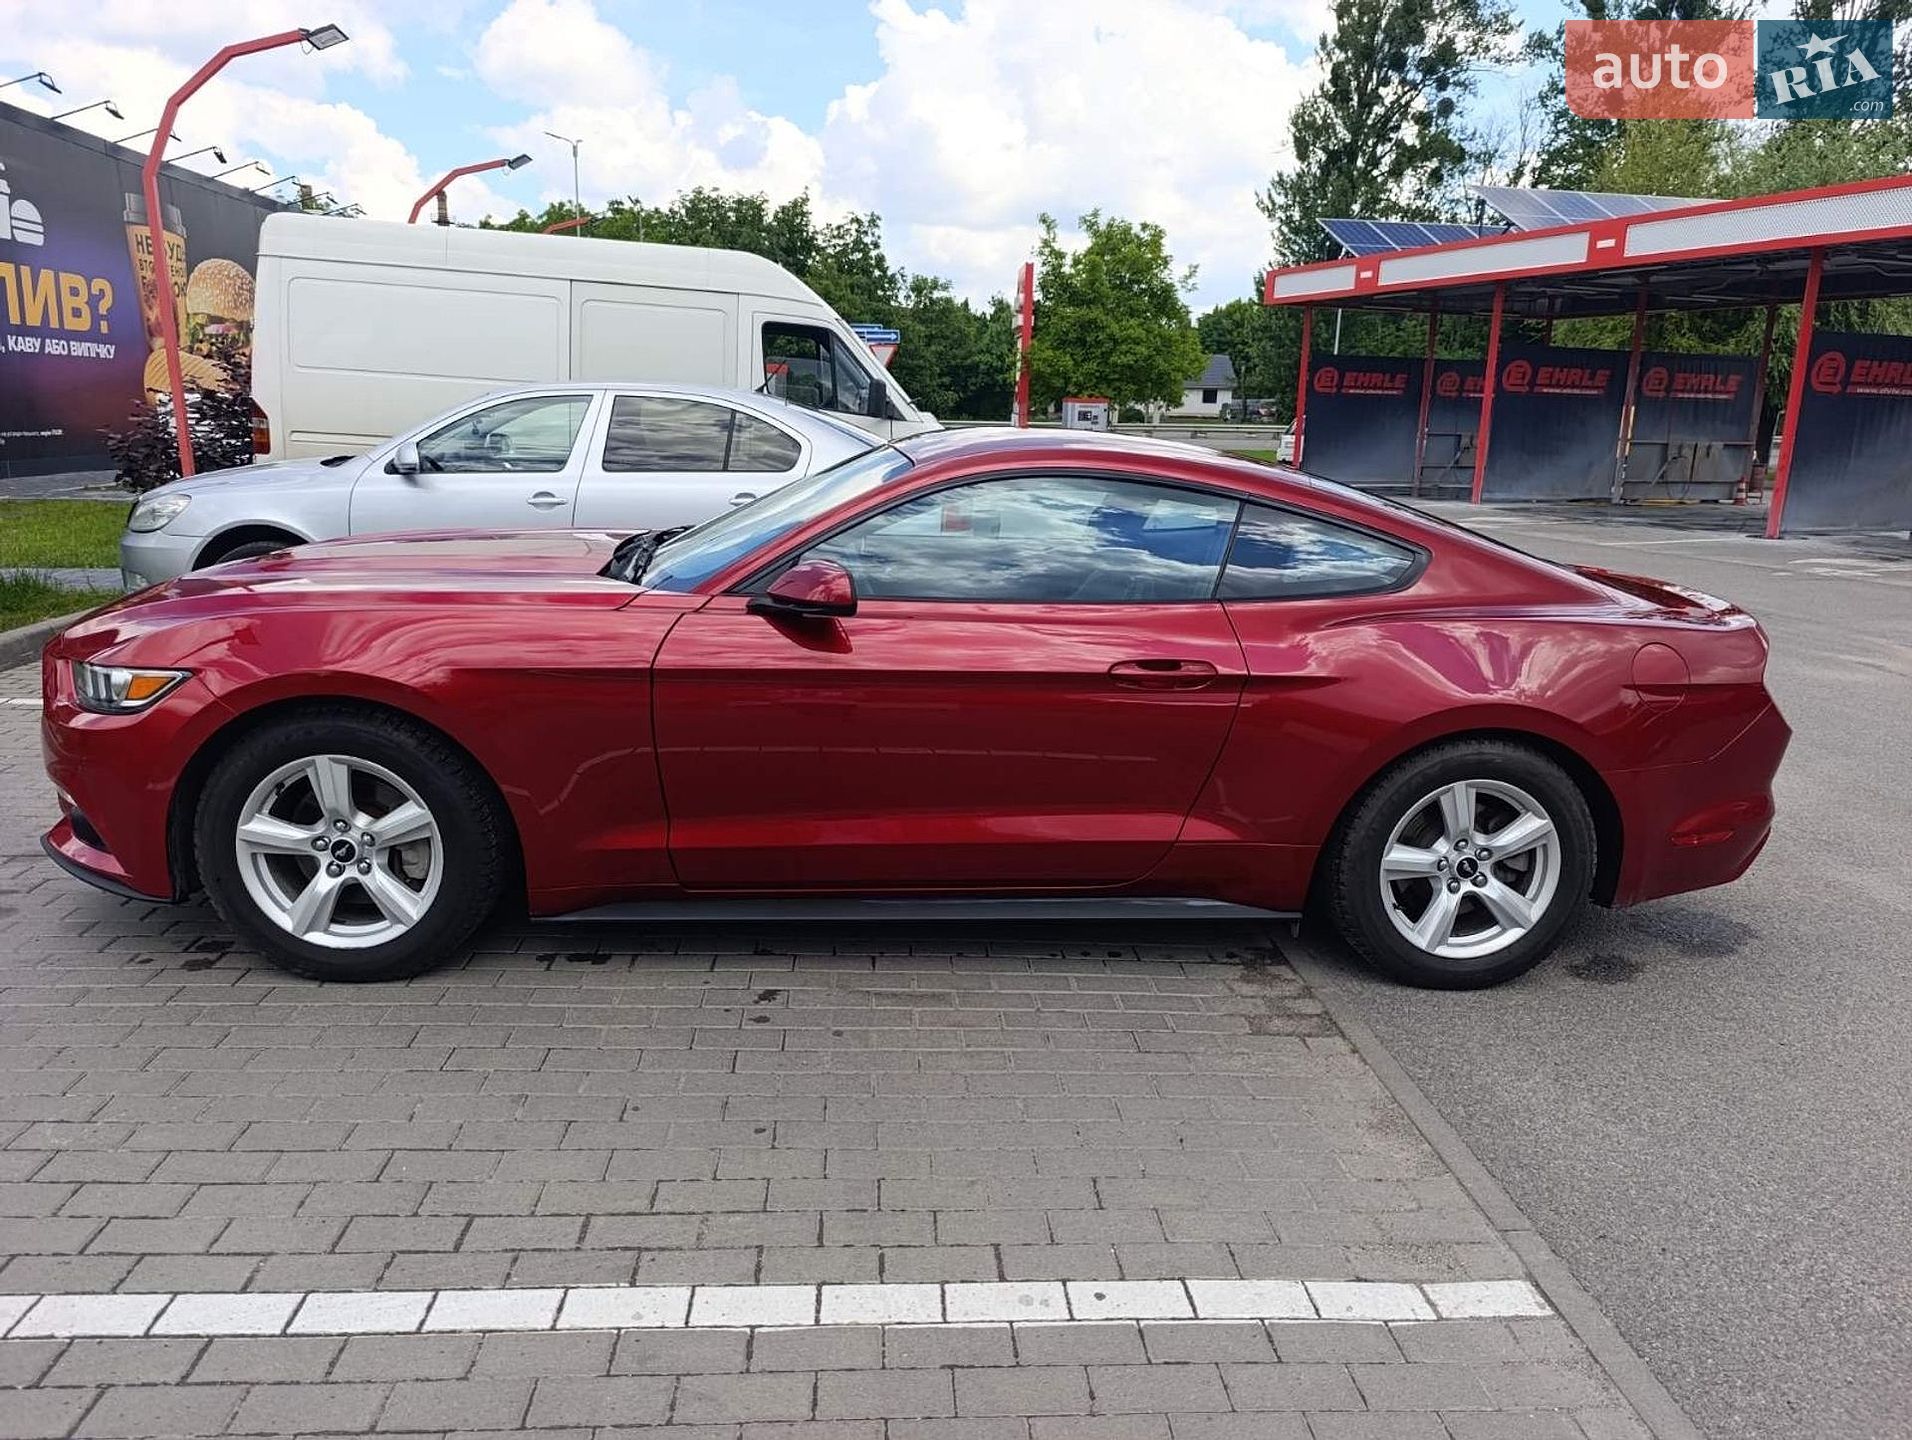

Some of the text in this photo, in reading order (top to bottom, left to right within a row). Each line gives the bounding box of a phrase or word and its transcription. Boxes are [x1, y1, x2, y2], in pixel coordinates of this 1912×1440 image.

[7, 334, 41, 353] КАВУ
[44, 338, 68, 355] АБО
[1343, 372, 1408, 388] EHRLE
[1536, 366, 1611, 387] EHRLE
[1673, 372, 1742, 392] EHRLE
[1849, 359, 1912, 385] EHRL
